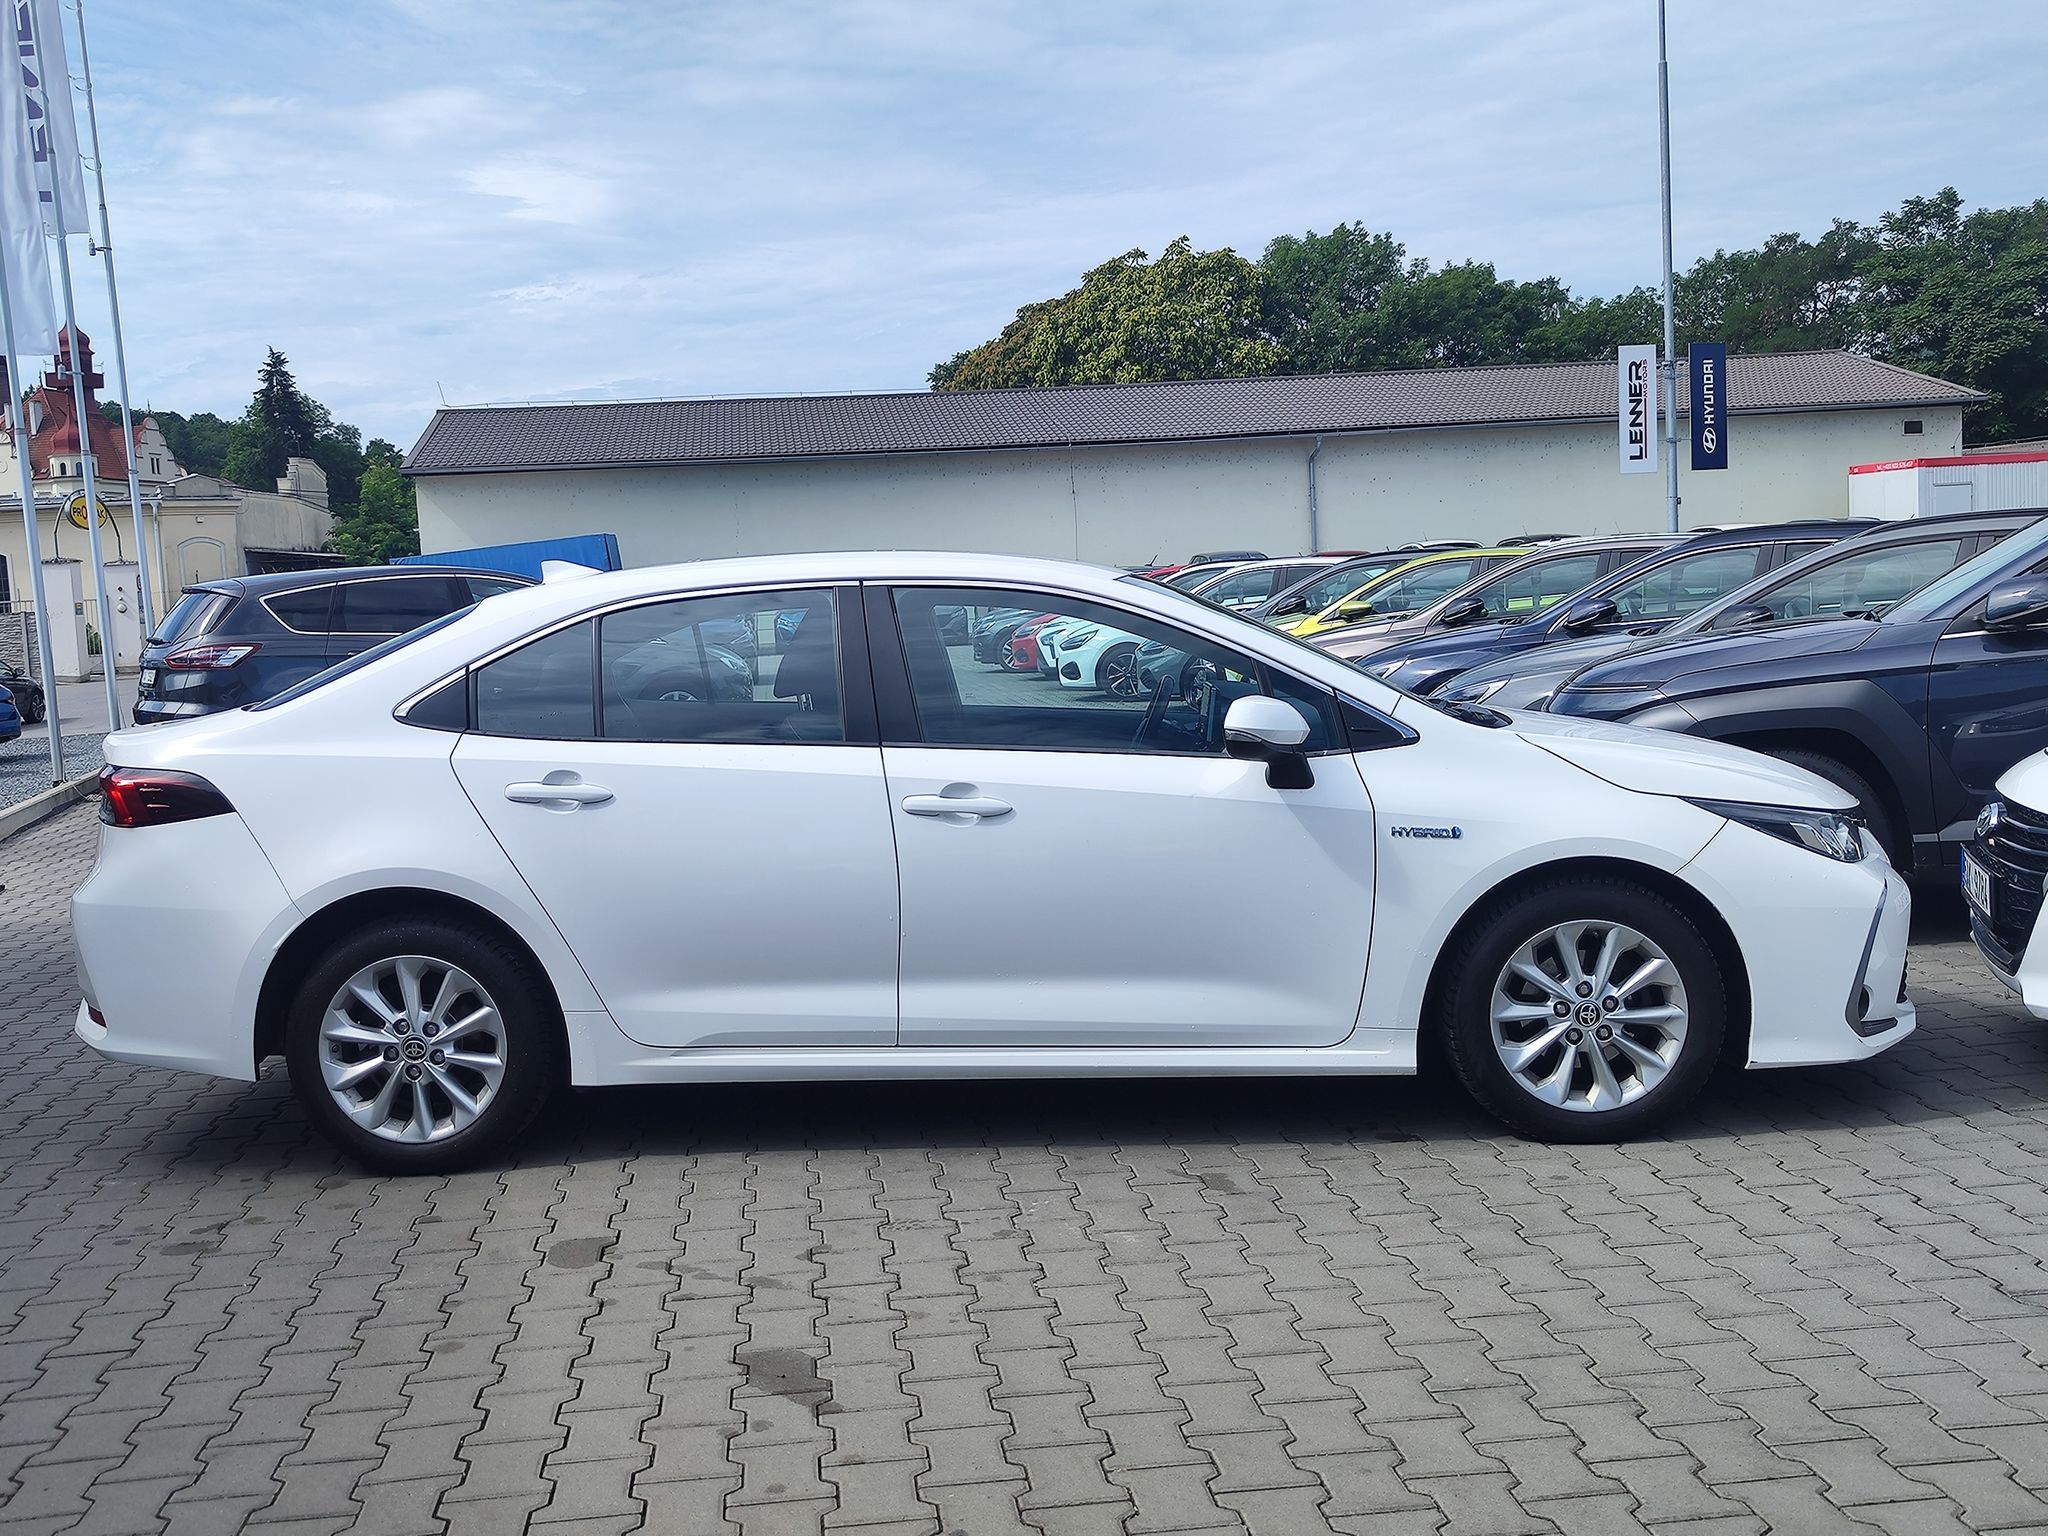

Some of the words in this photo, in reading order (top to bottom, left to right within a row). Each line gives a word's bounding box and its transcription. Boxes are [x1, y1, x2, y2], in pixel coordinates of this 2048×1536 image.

[1628, 359, 1644, 461] LENNER
[1703, 359, 1715, 425] HYUNDAI
[1391, 826, 1452, 839] HYBRID
